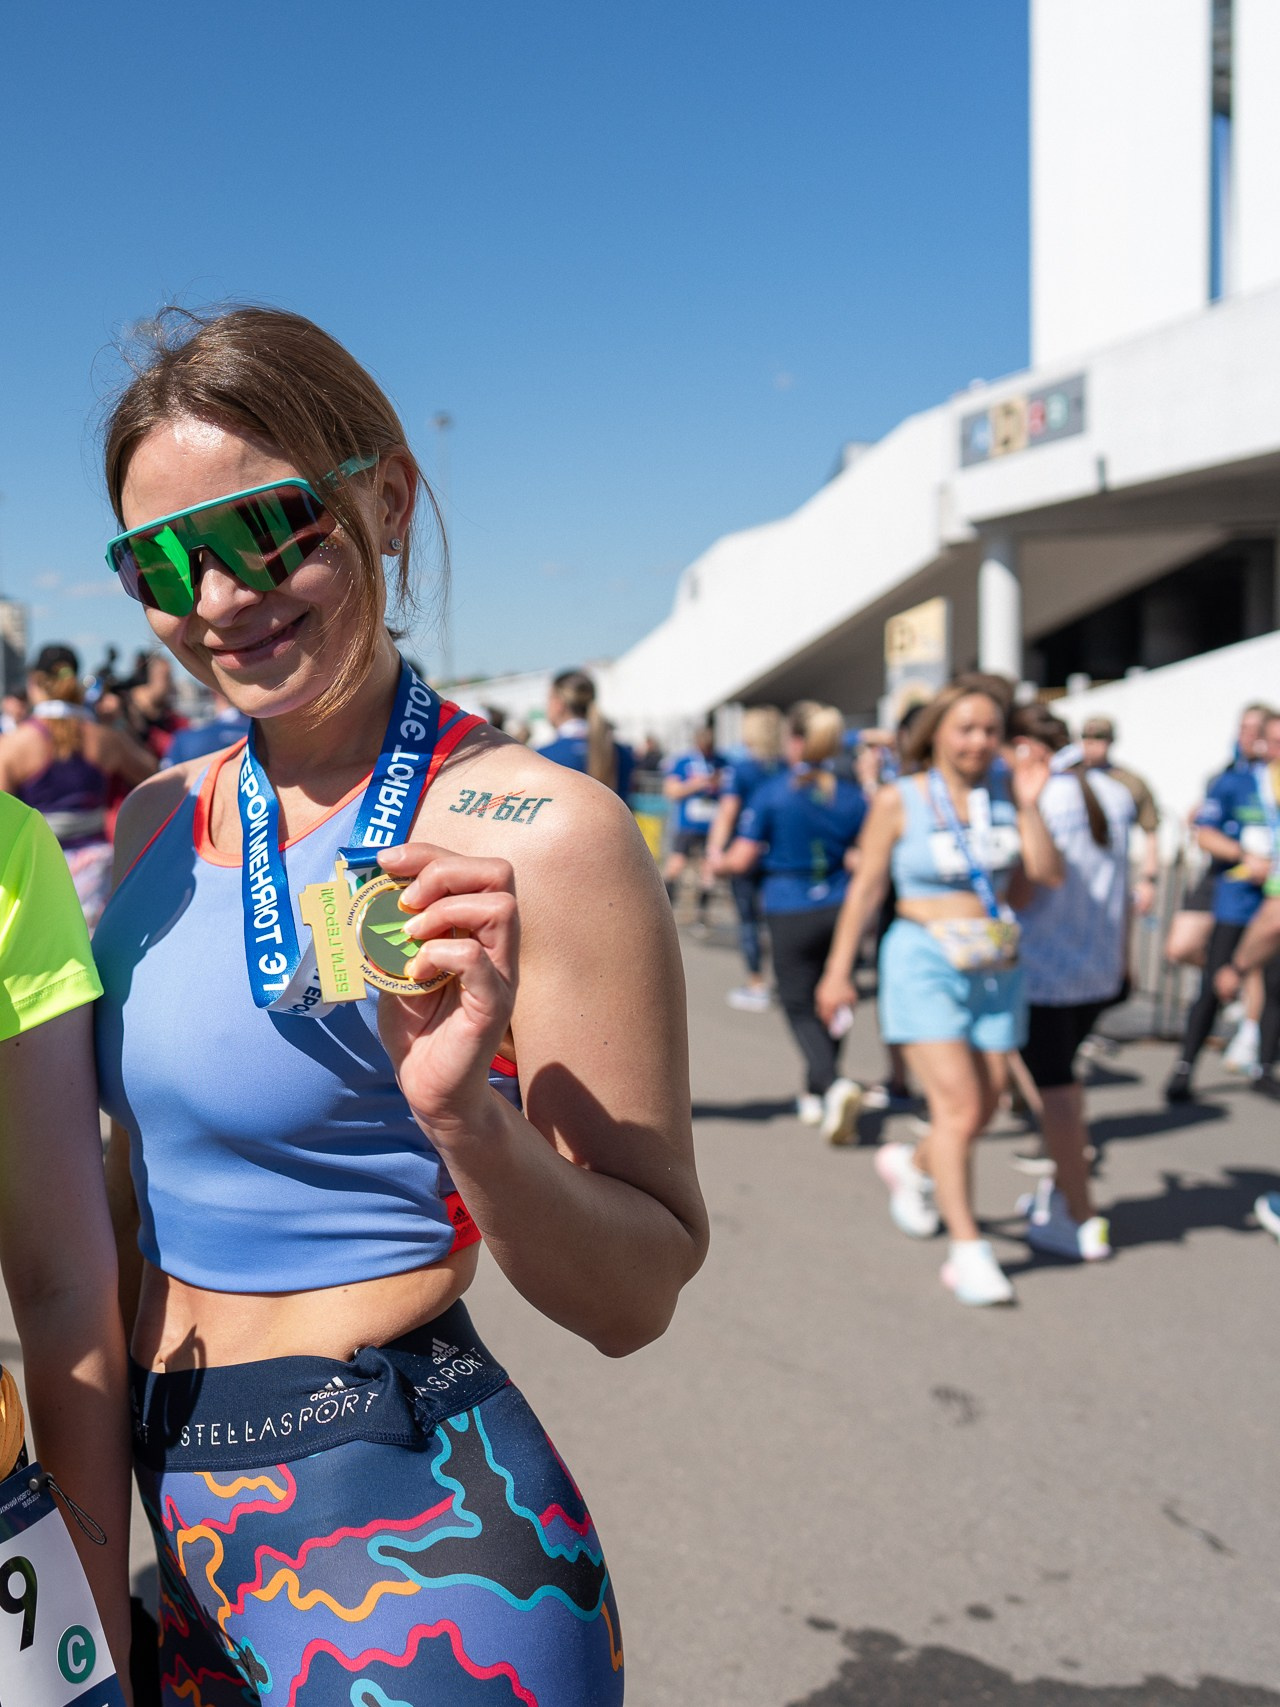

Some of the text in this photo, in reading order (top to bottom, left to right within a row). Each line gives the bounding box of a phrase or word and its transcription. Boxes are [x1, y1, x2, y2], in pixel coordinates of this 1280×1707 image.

[362, 673, 432, 848] ЕНЯЮТ ЭТОТ
[492, 795, 554, 824] БЕГ
[249, 829, 283, 945] МЕНЯЮТ
[319, 887, 343, 947] ГЕРОЙ!
[360, 963, 399, 990] НИЖНИЙ
[432, 1345, 460, 1365] adidas
[180, 1391, 379, 1447] STELLASPORT
